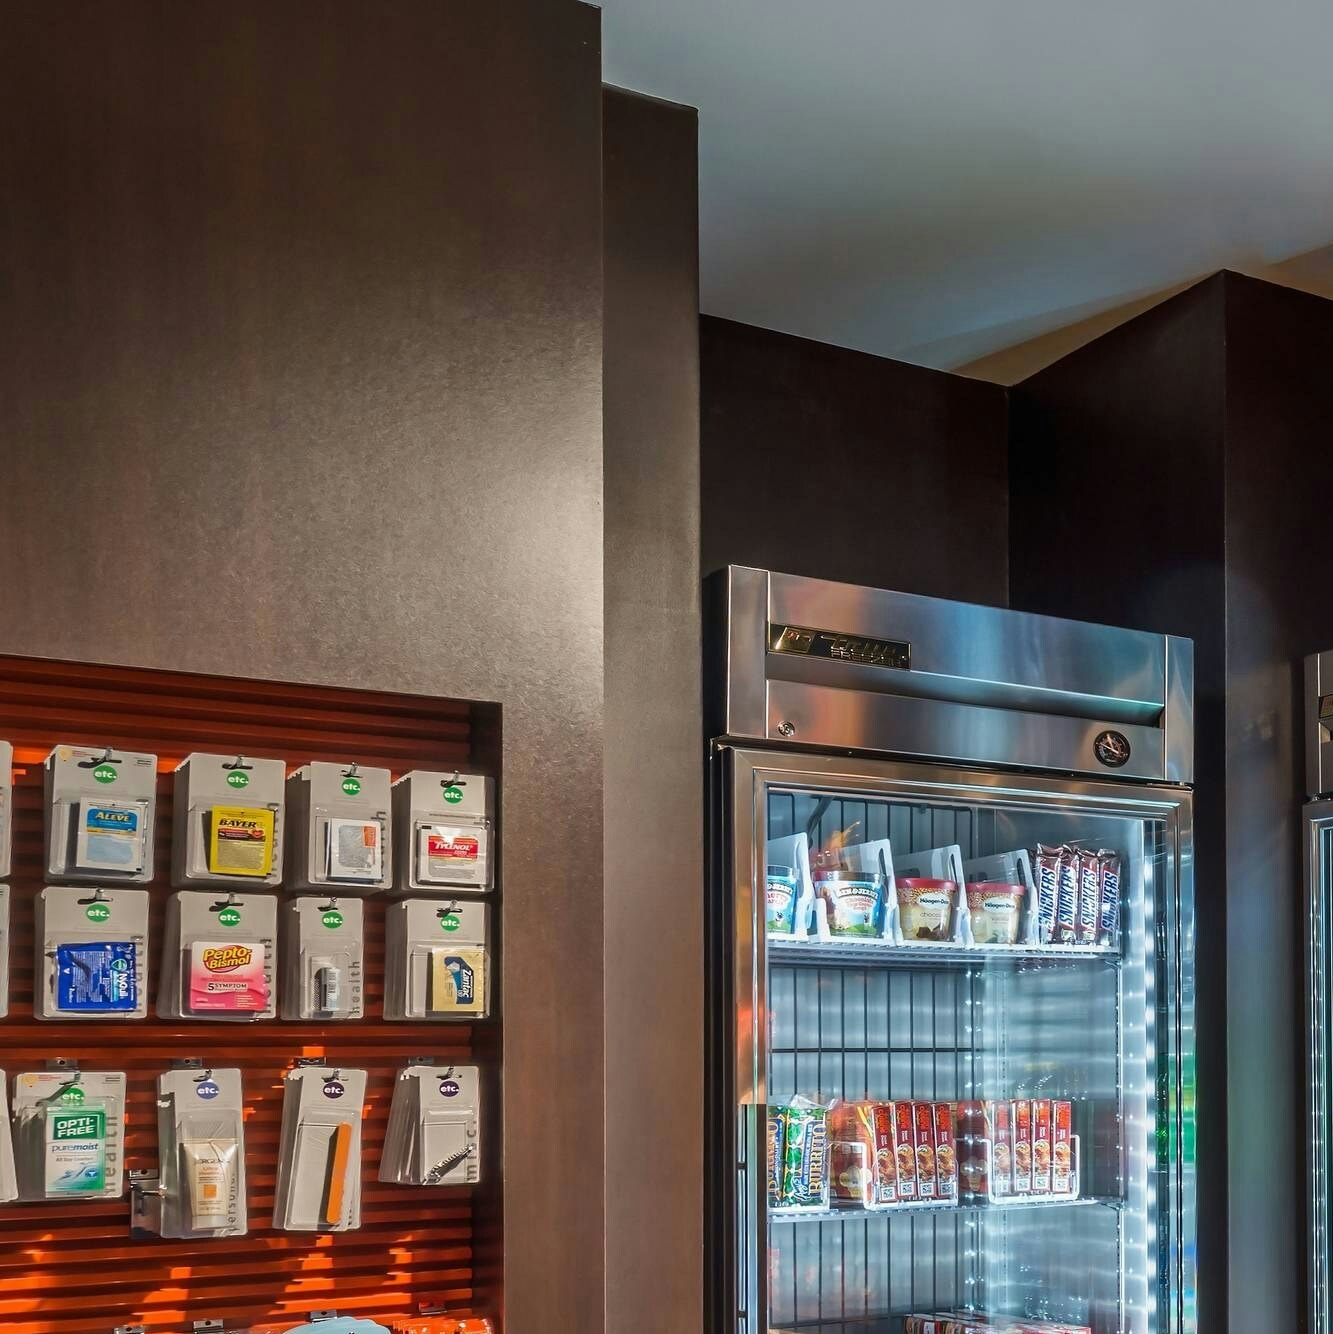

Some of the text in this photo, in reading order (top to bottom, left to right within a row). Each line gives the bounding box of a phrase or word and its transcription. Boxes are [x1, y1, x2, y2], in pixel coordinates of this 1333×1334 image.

[93, 770, 117, 780] etc.
[227, 776, 249, 785] etc.
[343, 783, 361, 792] etc.
[444, 791, 463, 799] etc.
[219, 819, 256, 829] BAYER
[87, 909, 110, 919] etc.
[219, 914, 241, 922] etc.
[323, 916, 343, 925] etc.
[442, 919, 460, 927] etc.
[203, 946, 253, 961] Pepto-
[209, 954, 250, 969] Bismol
[208, 983, 214, 991] 5
[462, 969, 473, 998] Zantac
[197, 1086, 220, 1096] etc.
[324, 1086, 345, 1095] etc.
[440, 1084, 459, 1093] etc.
[62, 1092, 84, 1102] etc.
[57, 1117, 94, 1129] OPTI-
[57, 1125, 95, 1138] FREE
[51, 1142, 99, 1153] puremoist
